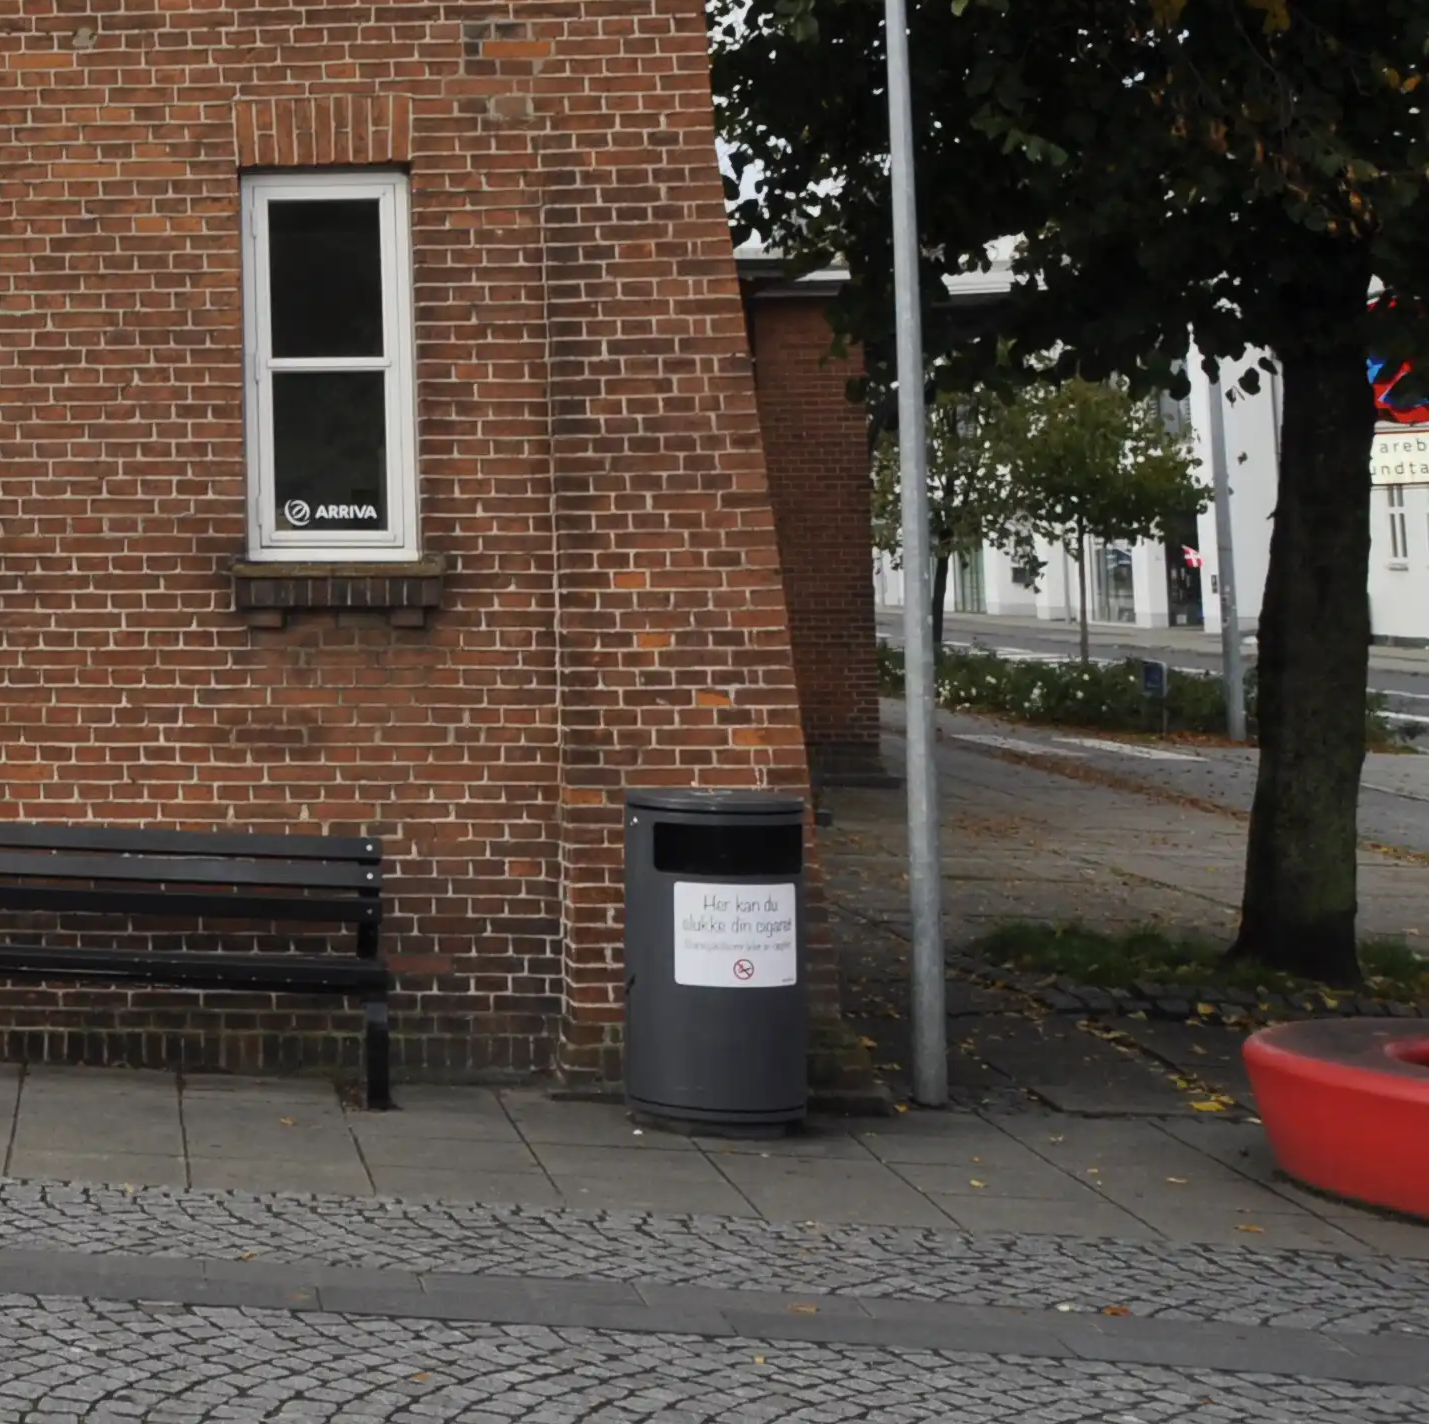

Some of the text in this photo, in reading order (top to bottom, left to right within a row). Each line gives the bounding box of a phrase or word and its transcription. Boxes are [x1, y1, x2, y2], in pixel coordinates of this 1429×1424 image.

[314, 504, 377, 519] ARRIVA
[736, 894, 761, 912] kan
[763, 893, 778, 912] du
[730, 916, 752, 933] din
